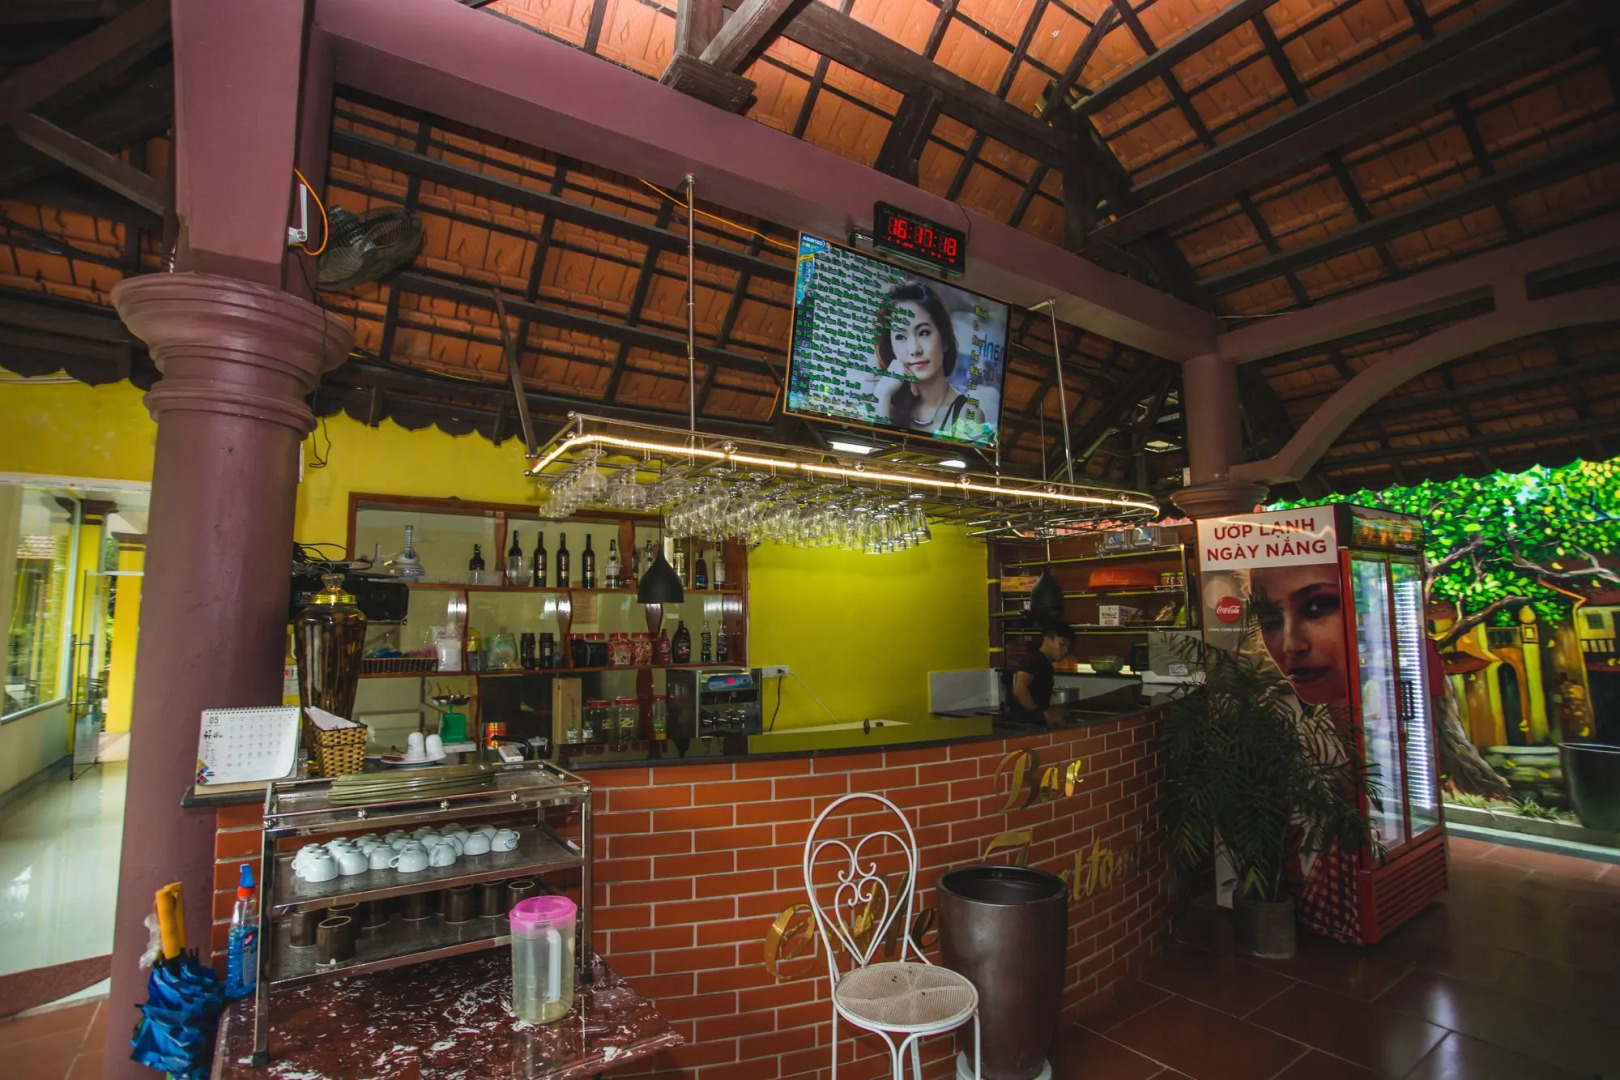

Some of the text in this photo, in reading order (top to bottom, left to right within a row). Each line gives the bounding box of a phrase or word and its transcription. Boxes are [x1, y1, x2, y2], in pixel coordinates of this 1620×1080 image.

[1214, 517, 1315, 541] ƯỚP LẠNH
[1207, 536, 1327, 562] NGÀY NẮNG
[994, 748, 1084, 813] Bar
